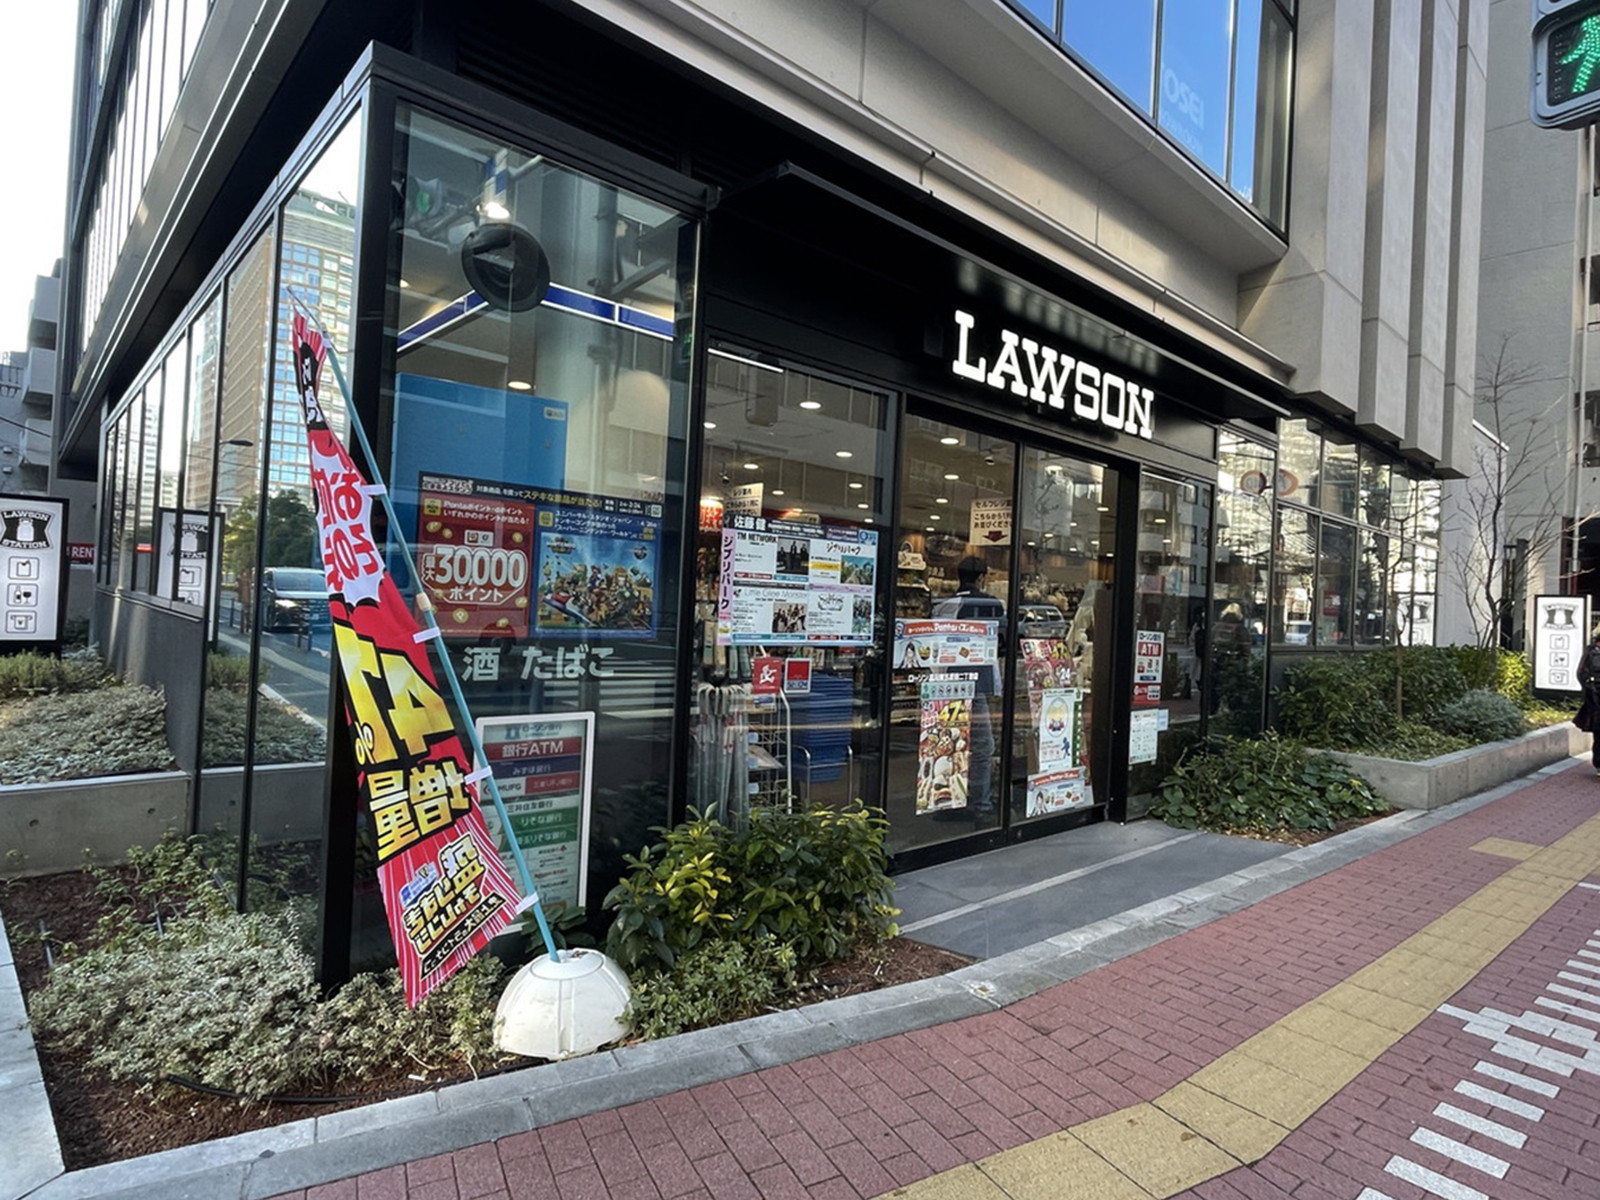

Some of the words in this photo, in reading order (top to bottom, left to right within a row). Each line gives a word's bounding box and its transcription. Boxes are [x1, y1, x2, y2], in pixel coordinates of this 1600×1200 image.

[953, 309, 1154, 439] LAWSON
[3, 511, 50, 521] LAWSON
[974, 520, 1012, 529] お並びくださ
[2, 539, 47, 549] STATION
[425, 555, 436, 581] 最大
[436, 547, 525, 588] 30,000
[719, 535, 734, 610] ジブリパーク
[449, 586, 504, 601] ポイント
[1141, 643, 1159, 656] ATM
[462, 647, 499, 681] 酒
[521, 644, 614, 680] たばこ
[502, 740, 564, 758] 銀行ATM
[521, 812, 562, 827] りそな銀行
